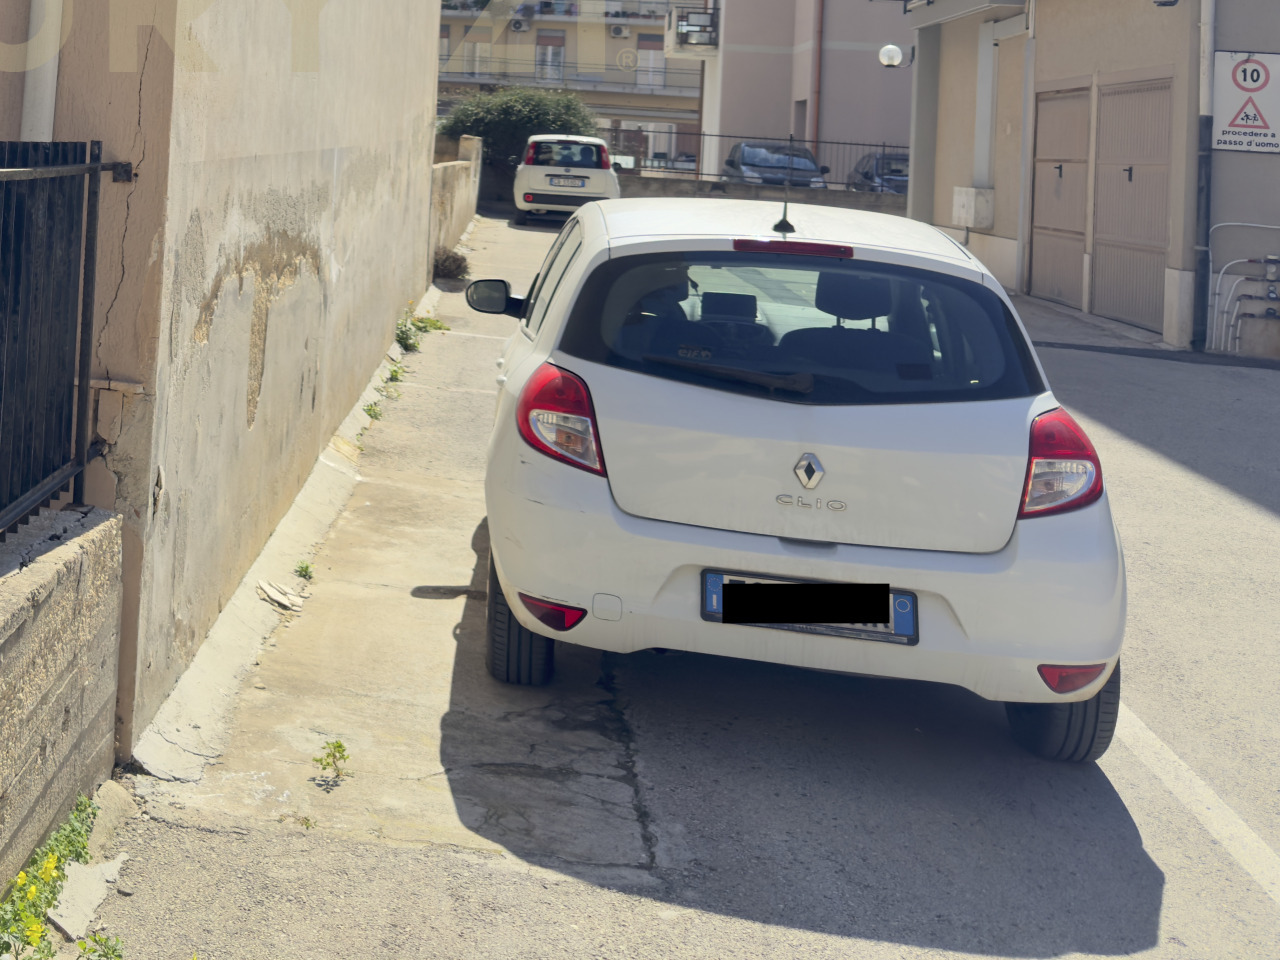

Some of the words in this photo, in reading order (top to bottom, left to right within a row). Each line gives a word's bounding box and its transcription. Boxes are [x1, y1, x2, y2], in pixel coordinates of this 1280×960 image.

[1241, 67, 1261, 83] 10
[1216, 138, 1244, 147] passo
[1246, 139, 1280, 148] d'uomo
[776, 494, 847, 512] CLIO
